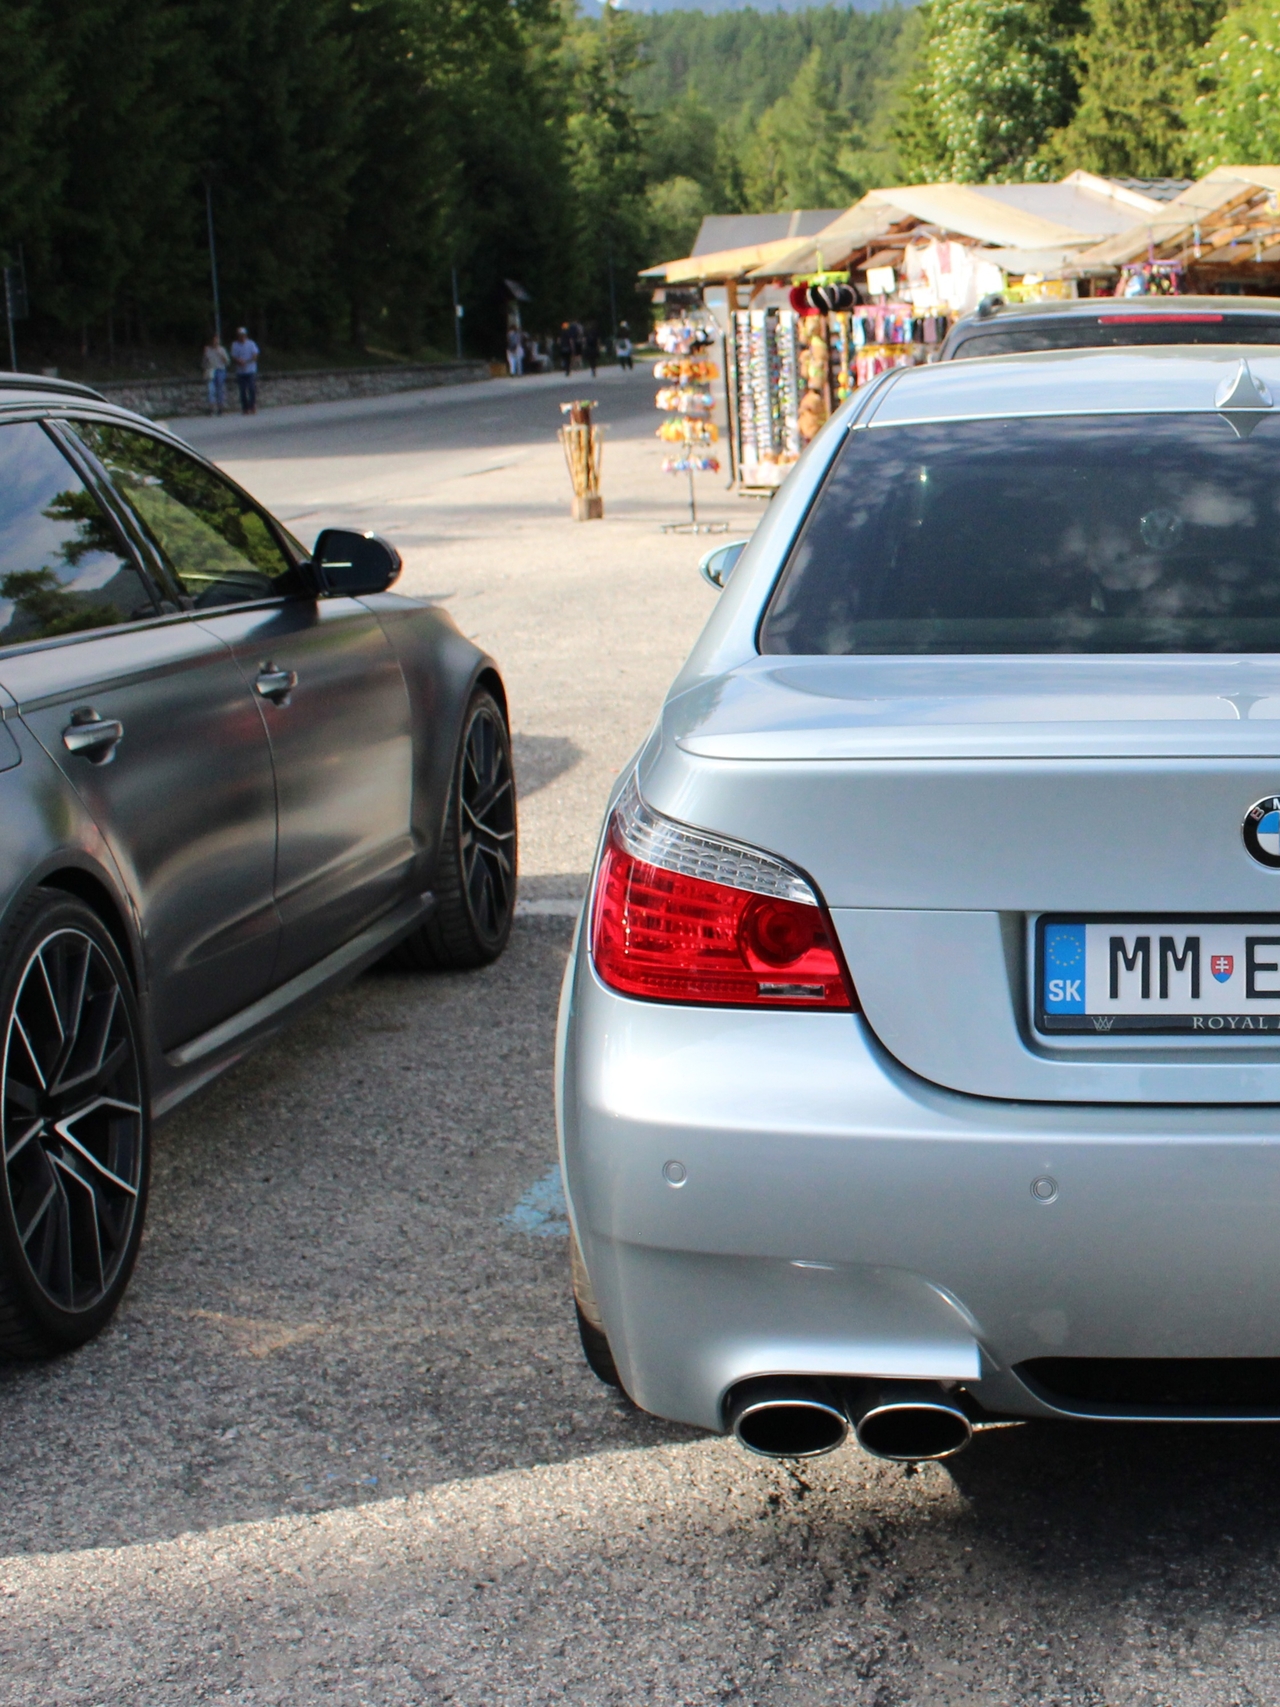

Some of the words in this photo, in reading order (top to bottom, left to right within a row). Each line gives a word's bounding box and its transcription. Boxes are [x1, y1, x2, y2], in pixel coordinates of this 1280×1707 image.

[1108, 936, 1200, 999] MM
[1048, 979, 1082, 1002] SK
[1193, 1016, 1269, 1030] ROYAL
